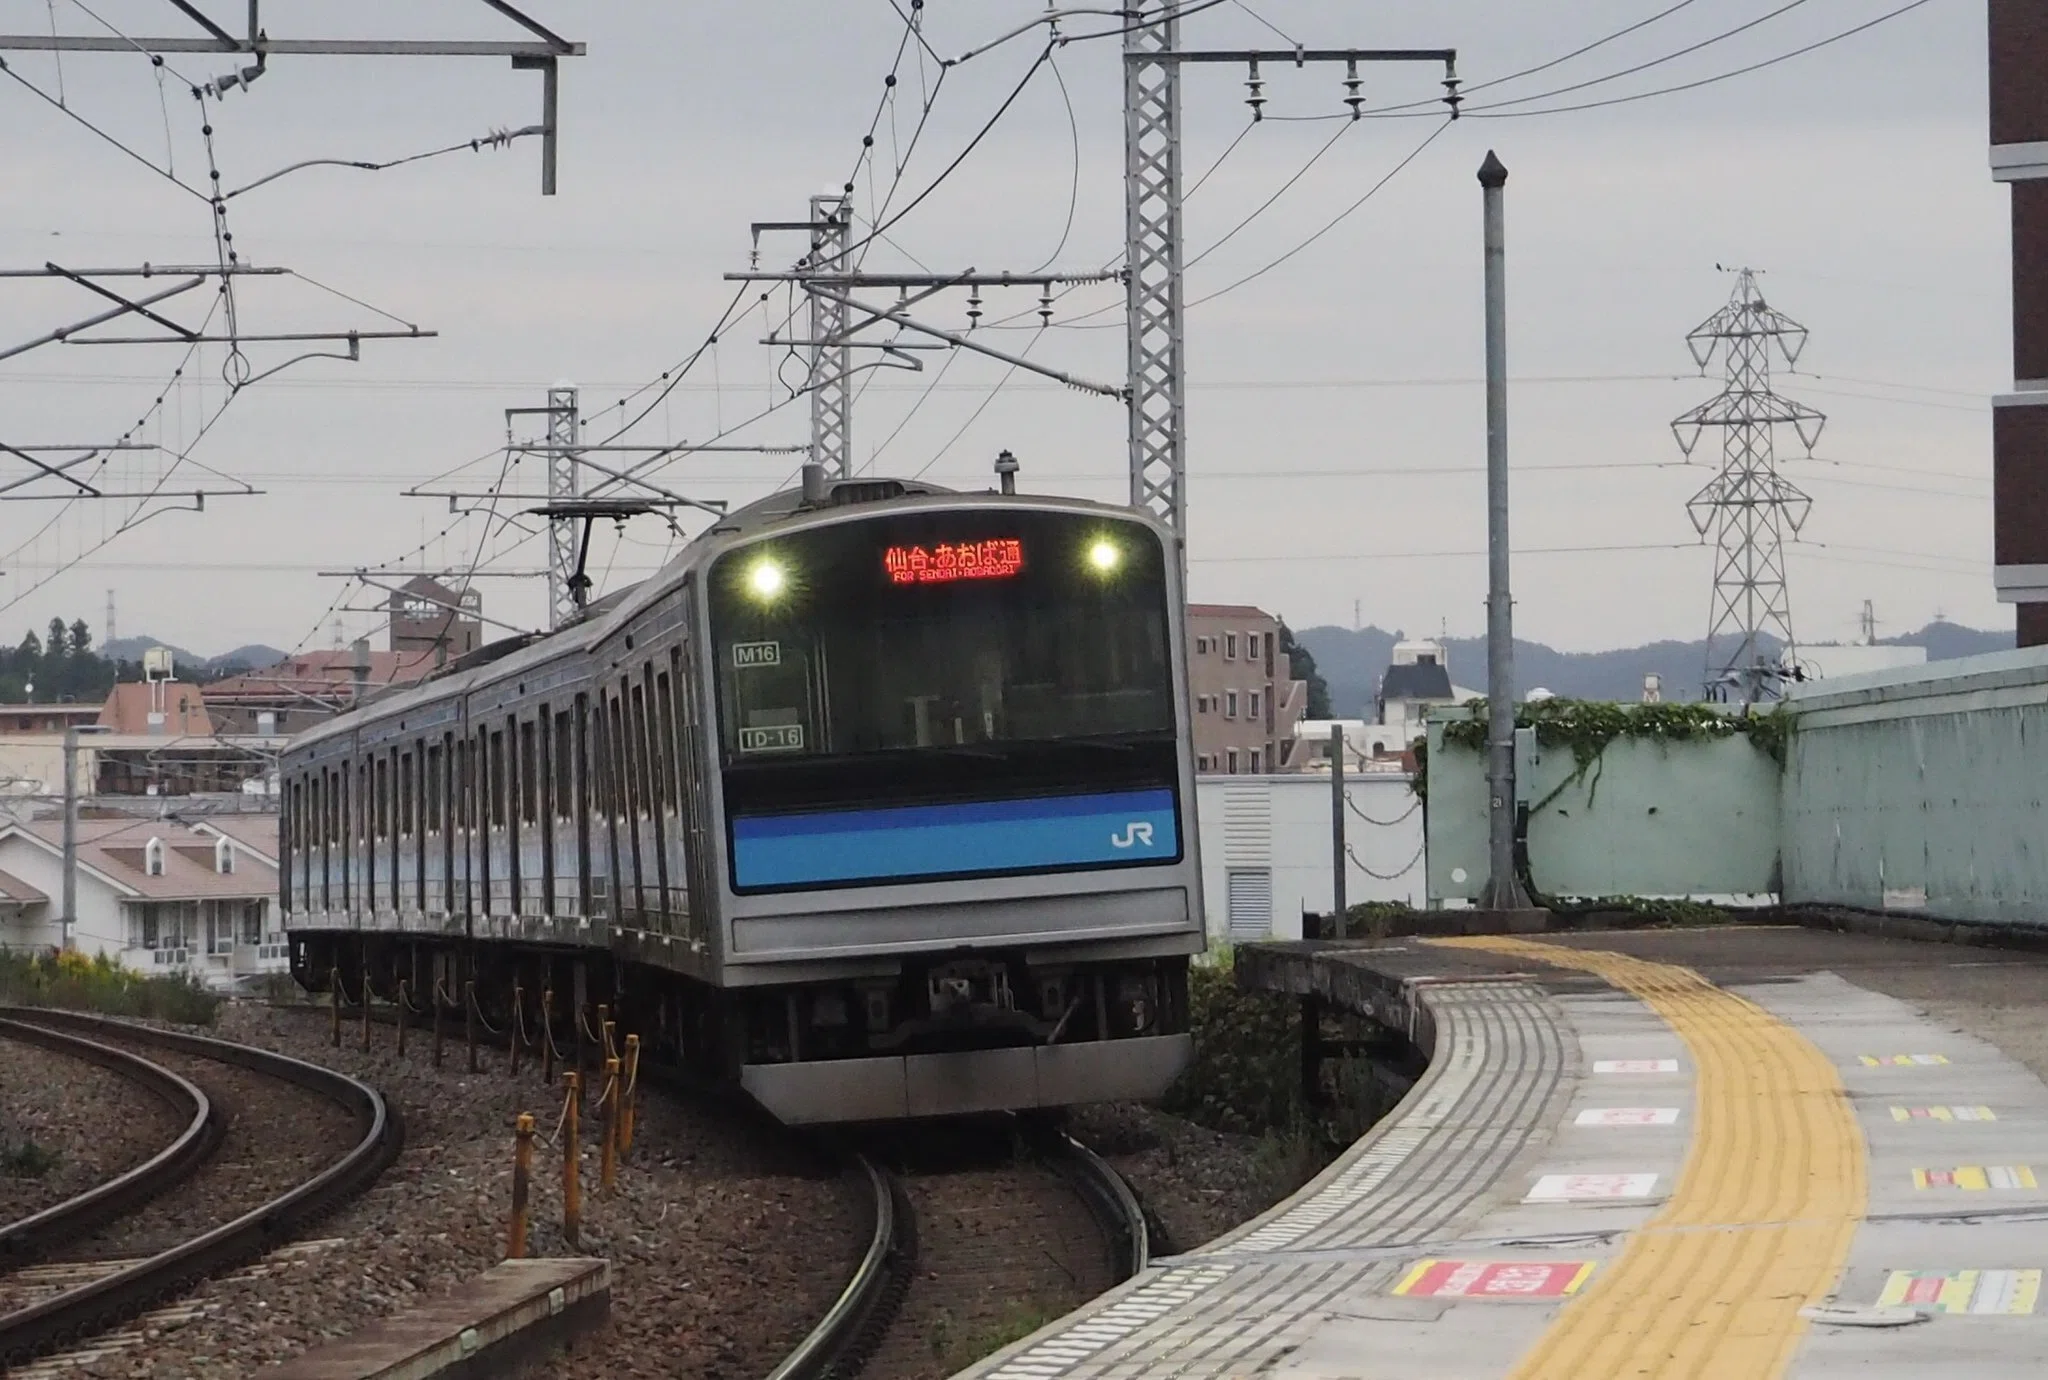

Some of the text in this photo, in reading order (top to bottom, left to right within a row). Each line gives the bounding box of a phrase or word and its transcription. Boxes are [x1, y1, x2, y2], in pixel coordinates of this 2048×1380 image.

[894, 570, 914, 581] FOR
[738, 646, 774, 663] M16
[1111, 822, 1153, 847] JR
